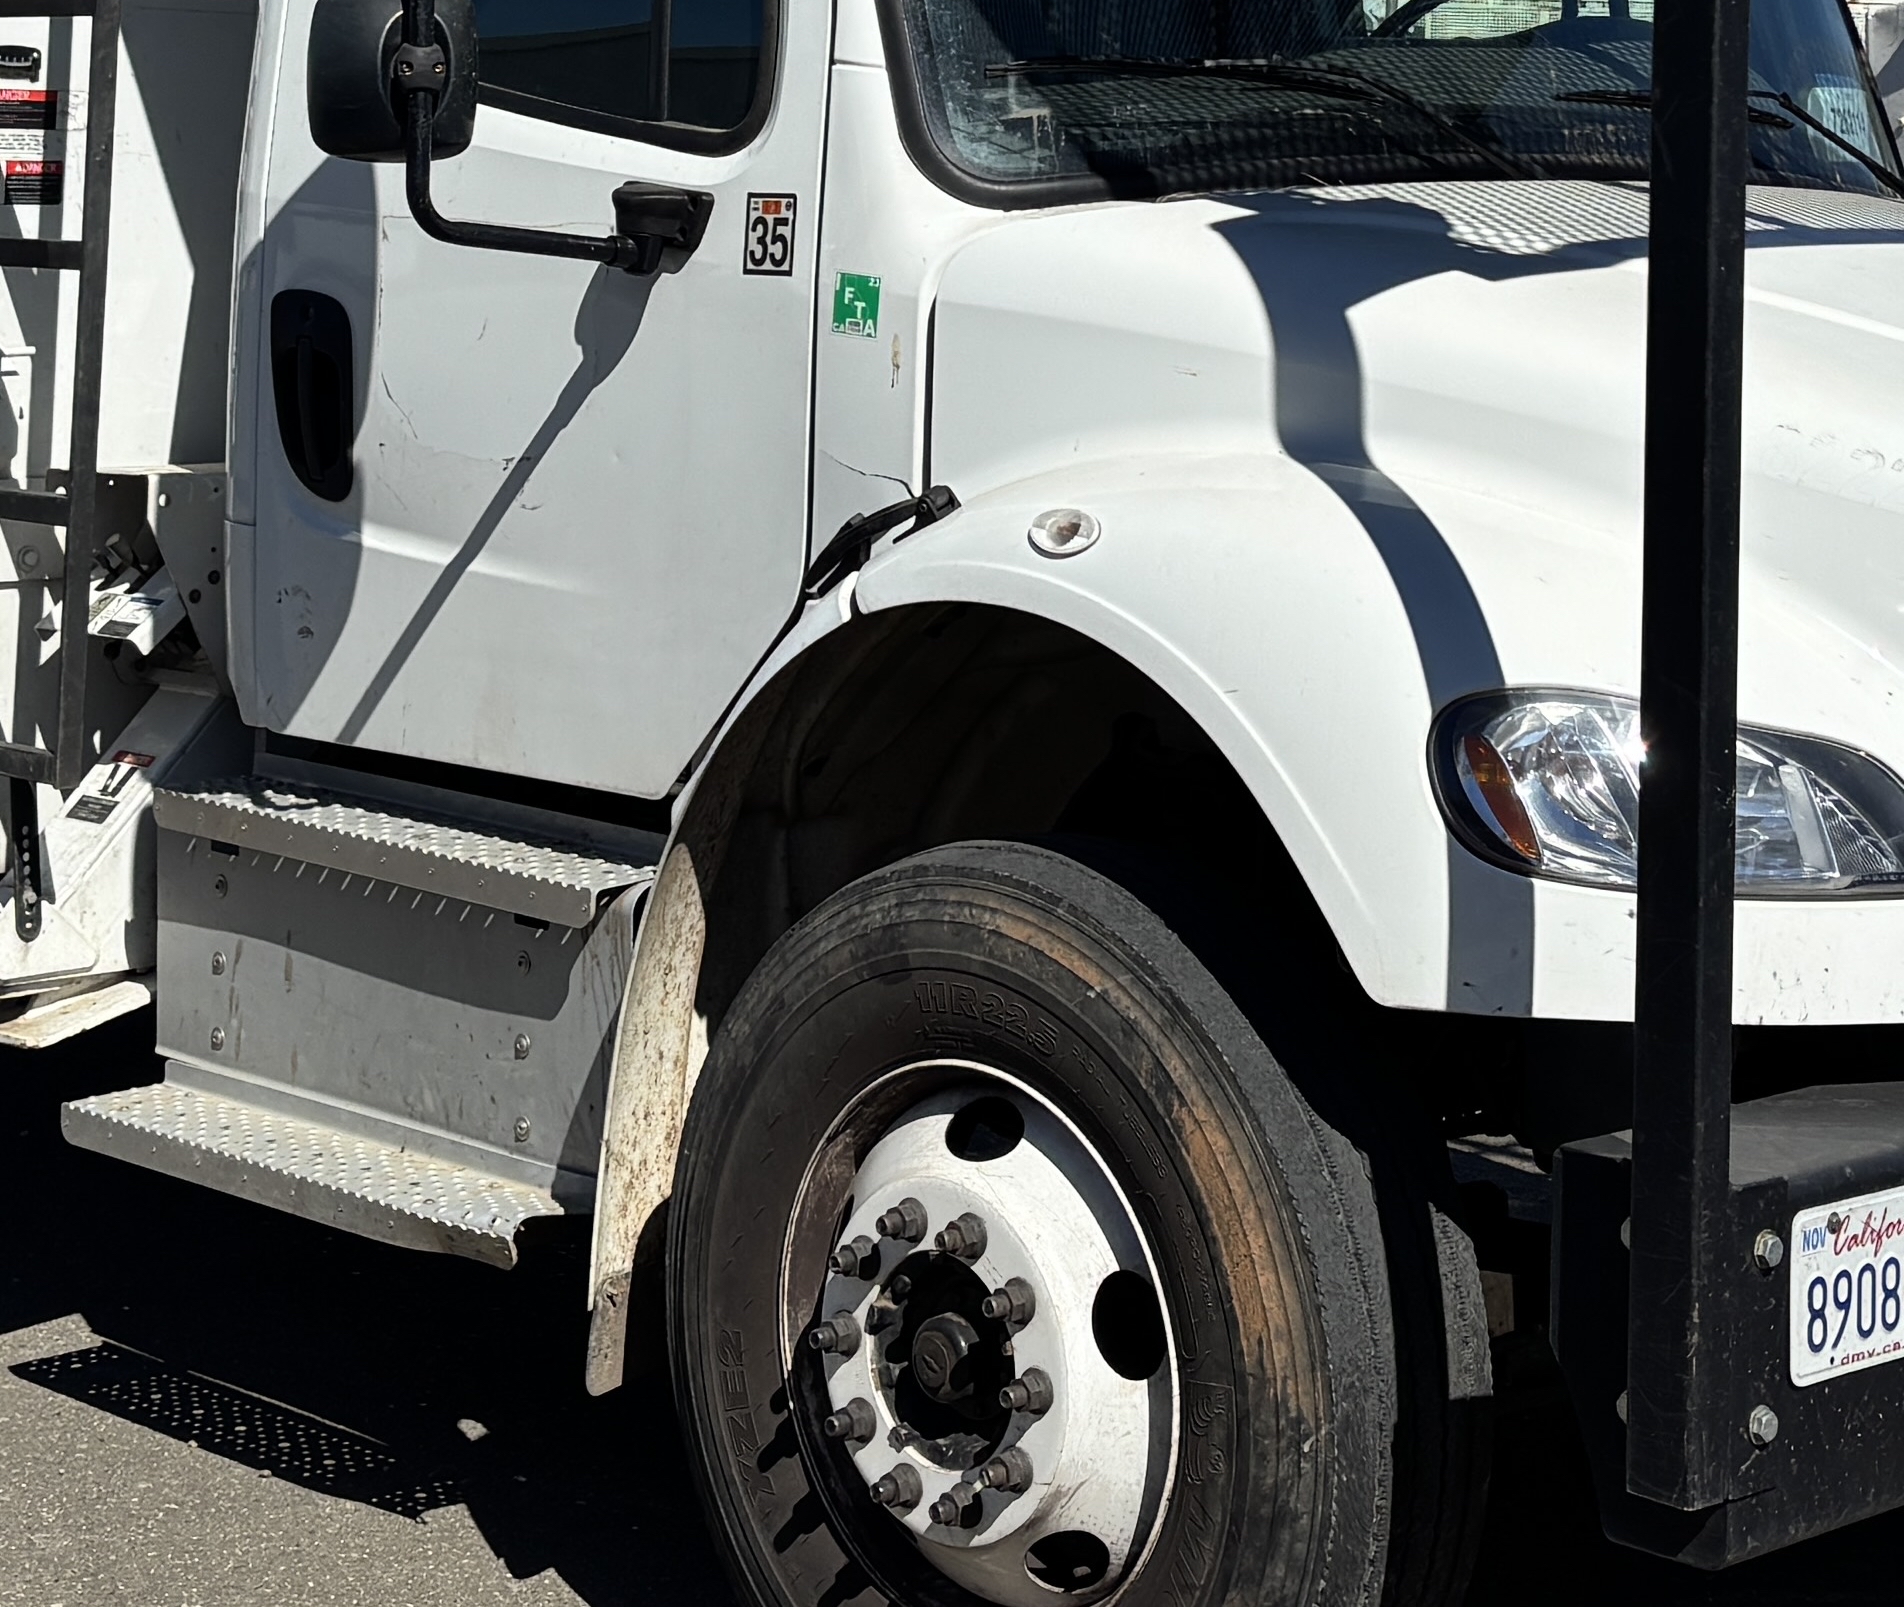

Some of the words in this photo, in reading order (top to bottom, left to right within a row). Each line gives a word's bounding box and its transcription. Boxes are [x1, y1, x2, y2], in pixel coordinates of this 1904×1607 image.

[749, 216, 790, 267] 35
[913, 980, 1060, 1057] 11R22.5
[1802, 1226, 1828, 1252] NOV
